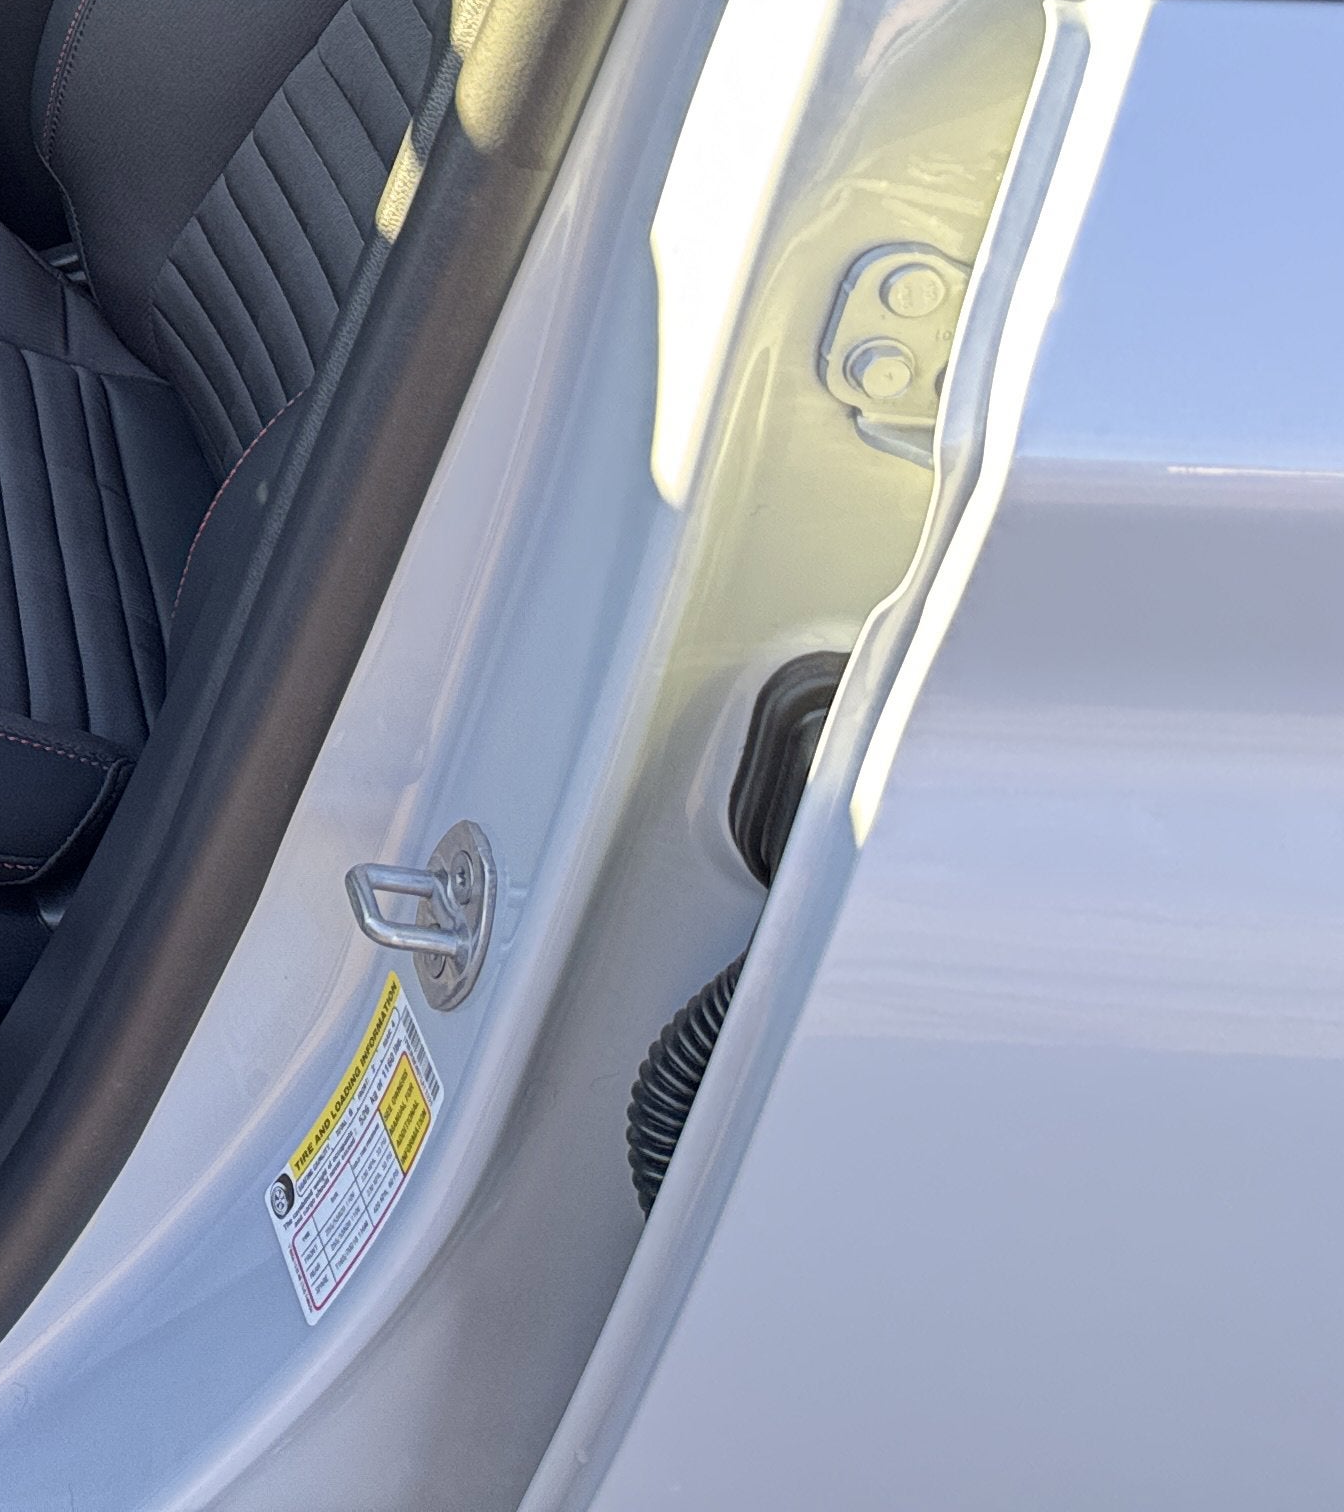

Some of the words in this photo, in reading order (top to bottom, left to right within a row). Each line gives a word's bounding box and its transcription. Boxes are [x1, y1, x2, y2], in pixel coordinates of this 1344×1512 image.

[294, 1140, 314, 1171] TIRE
[314, 1116, 330, 1145] AND
[330, 1064, 360, 1119] LOADING
[359, 981, 397, 1066] INFORMATION
[358, 1104, 369, 1126] 526
[369, 1087, 378, 1106] kg
[376, 1077, 382, 1092] or
[389, 1100, 406, 1136] MANUAL
[404, 1081, 413, 1102] FOR
[395, 1098, 418, 1147] ADDITIONAL
[400, 1108, 426, 1165] INFORMATION
